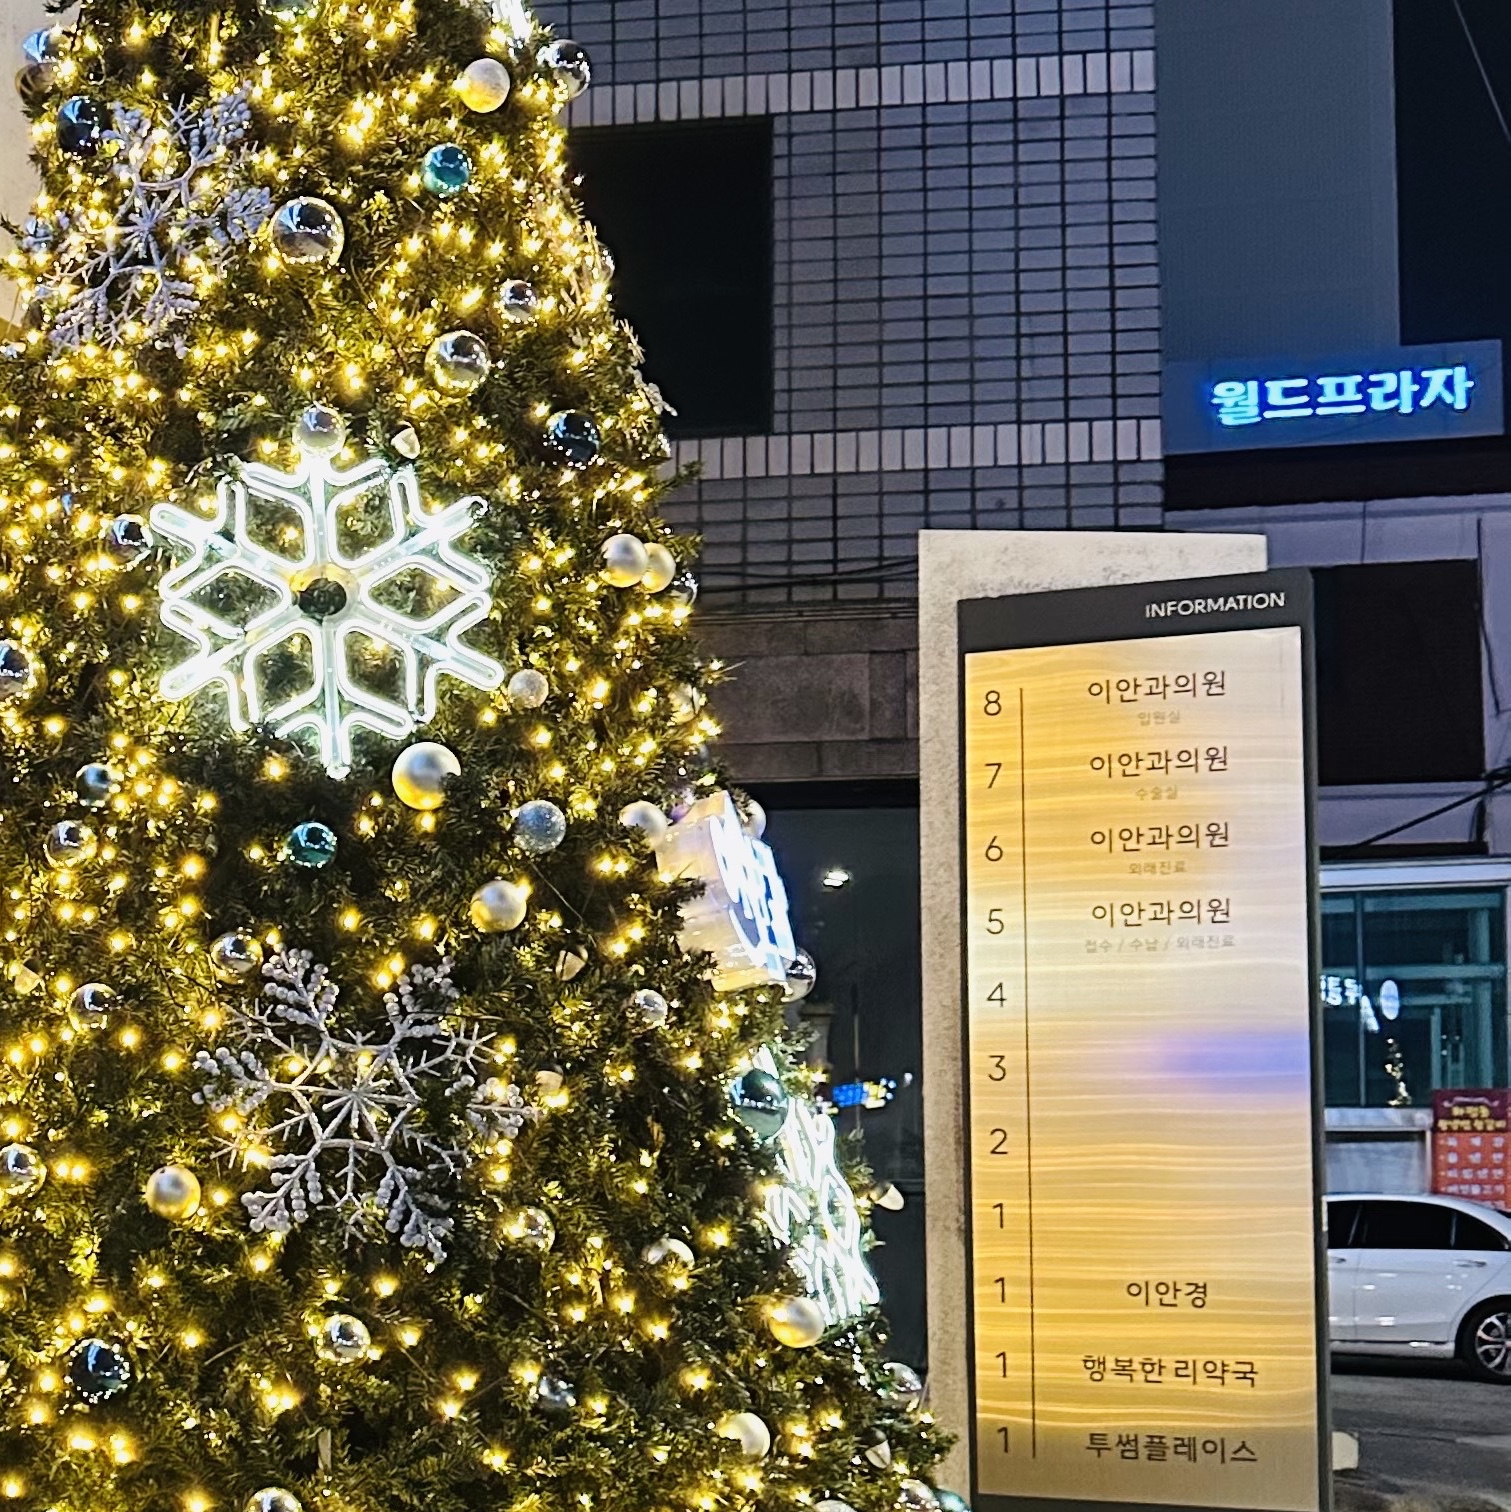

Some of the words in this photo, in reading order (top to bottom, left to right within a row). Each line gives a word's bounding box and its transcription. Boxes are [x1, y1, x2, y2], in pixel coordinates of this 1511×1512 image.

[1210, 364, 1475, 427] 월드프라자
[1145, 592, 1286, 618] INFORMATION
[983, 690, 1003, 716] 8
[1087, 670, 1226, 704] 이안과의원
[985, 762, 1003, 789] 7
[1089, 745, 1229, 778] 이안과의원
[984, 836, 1003, 862] 6
[1090, 820, 1230, 854] 이안과의원
[986, 908, 1005, 935] 5
[1092, 897, 1231, 928] 이안과의원
[987, 982, 1007, 1007] 4
[987, 1055, 1007, 1082] 3
[989, 1128, 1009, 1155] 2
[992, 1202, 1005, 1229] 1
[994, 1277, 1007, 1303] 1
[1126, 1280, 1209, 1308] 이안경
[995, 1352, 1008, 1378] 1
[997, 1426, 1010, 1453] 1
[1084, 1432, 1259, 1464] 투썸플레이스
